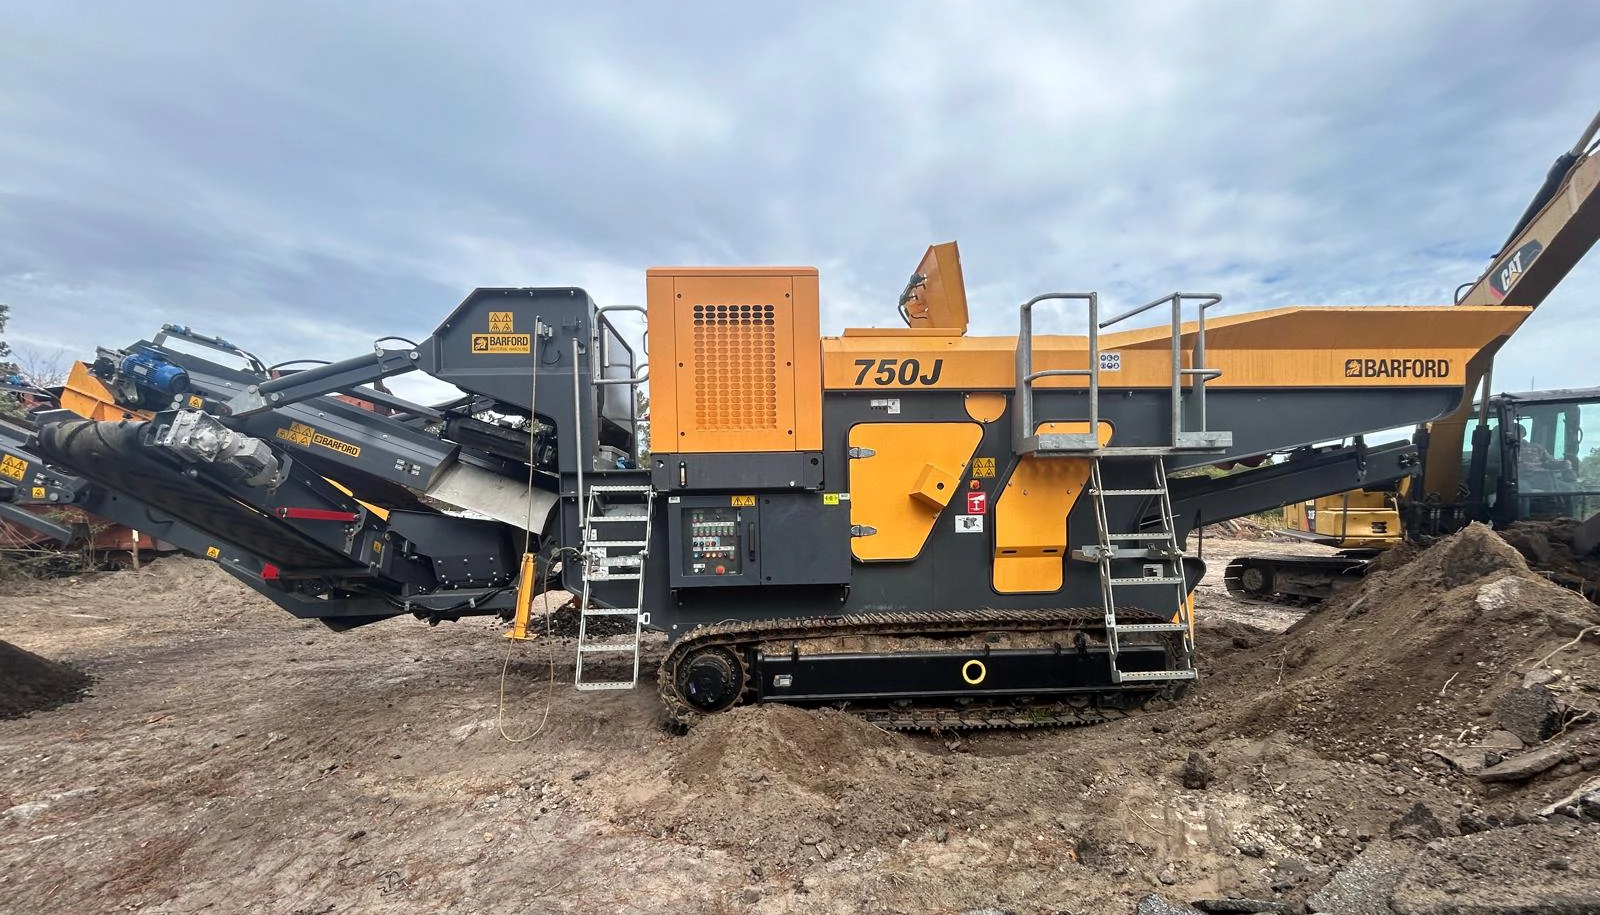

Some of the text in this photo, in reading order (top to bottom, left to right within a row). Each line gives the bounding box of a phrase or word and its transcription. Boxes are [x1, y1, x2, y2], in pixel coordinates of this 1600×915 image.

[1501, 251, 1522, 291] CAT
[489, 336, 529, 346] BARFORD
[854, 359, 944, 386] 750J
[1364, 359, 1450, 378] BARFORD
[321, 438, 358, 456] BARFORD
